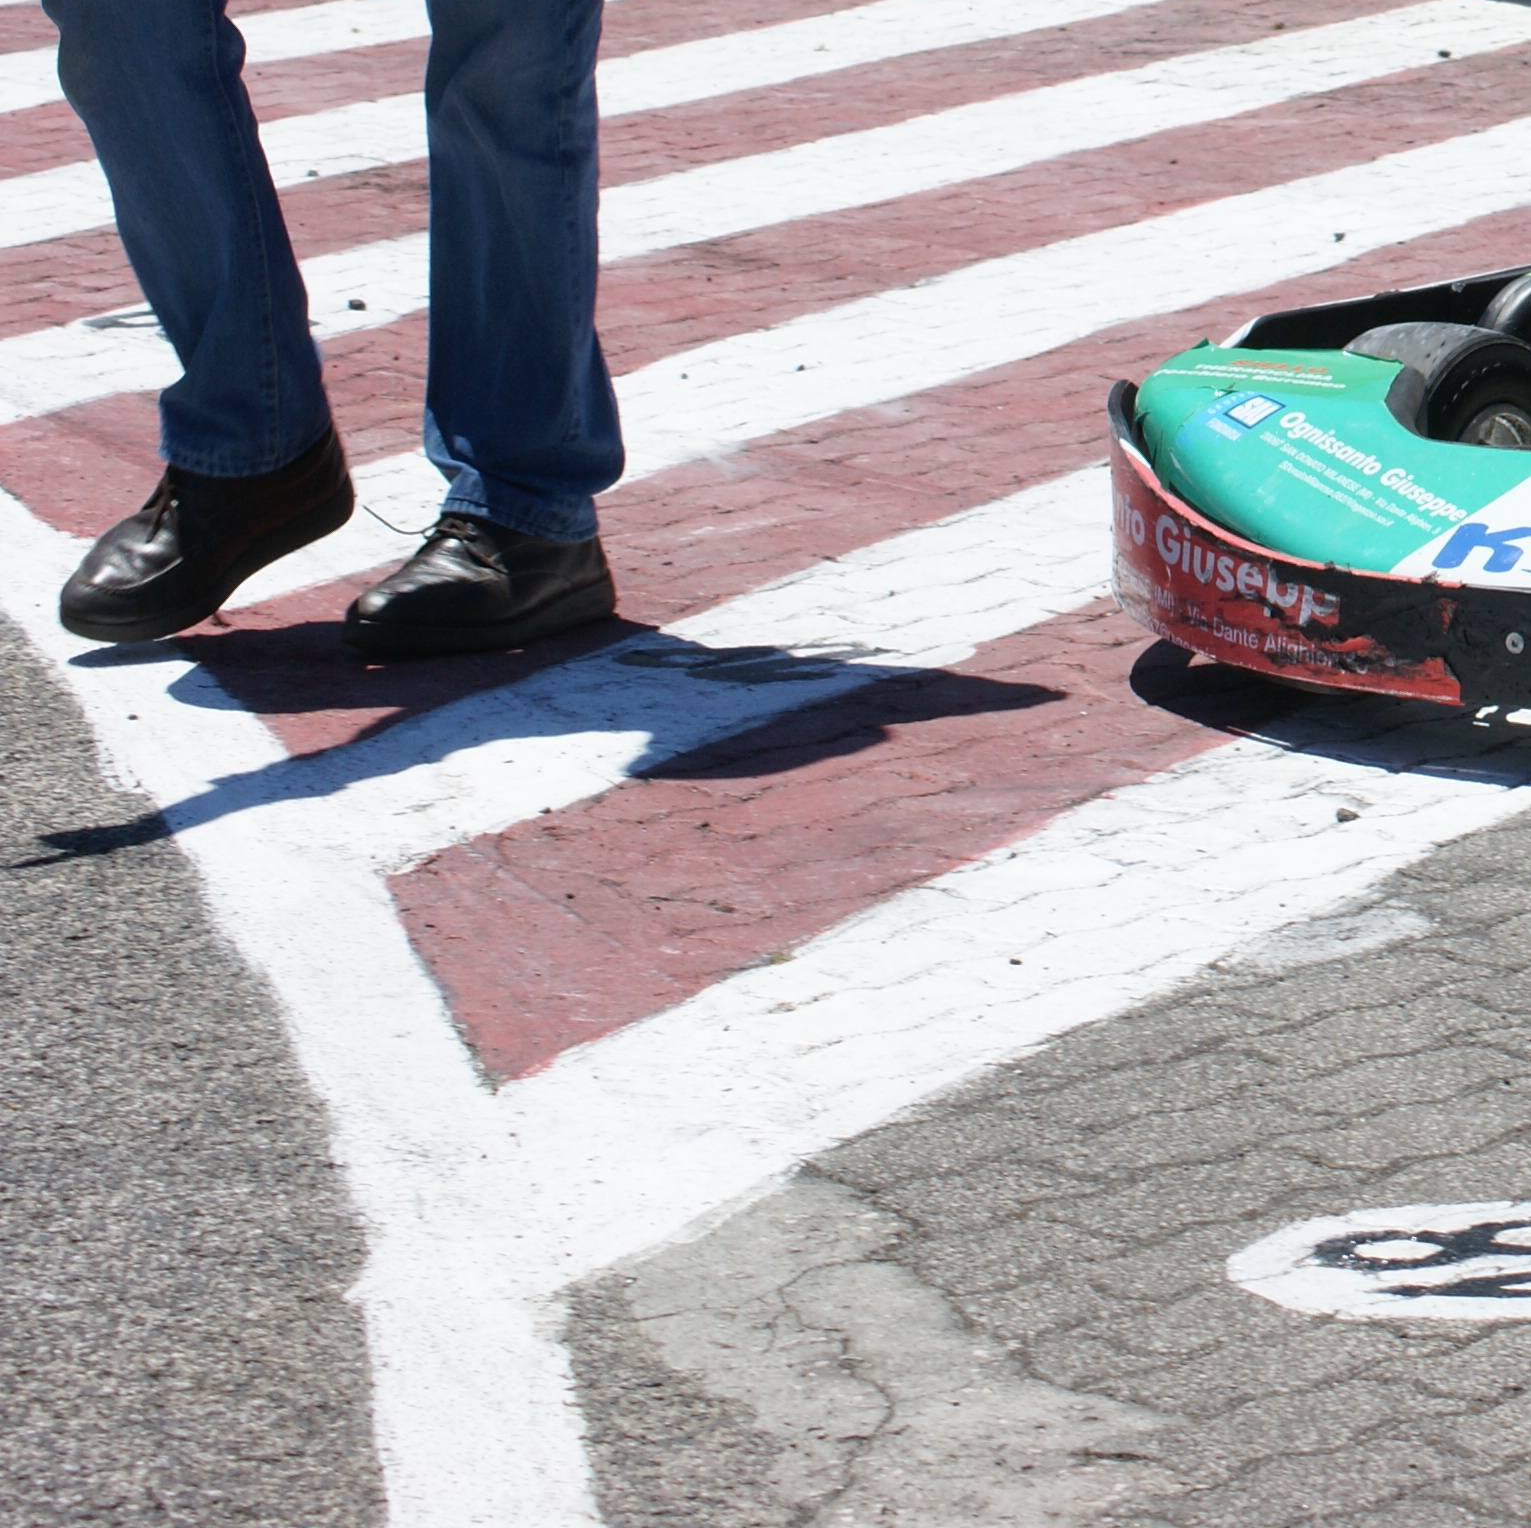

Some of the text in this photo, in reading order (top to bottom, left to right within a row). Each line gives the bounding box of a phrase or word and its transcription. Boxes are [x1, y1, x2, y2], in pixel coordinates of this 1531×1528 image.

[1279, 410, 1468, 523] Ognissanto Giuseppe
[1212, 614, 1259, 650] Dante
